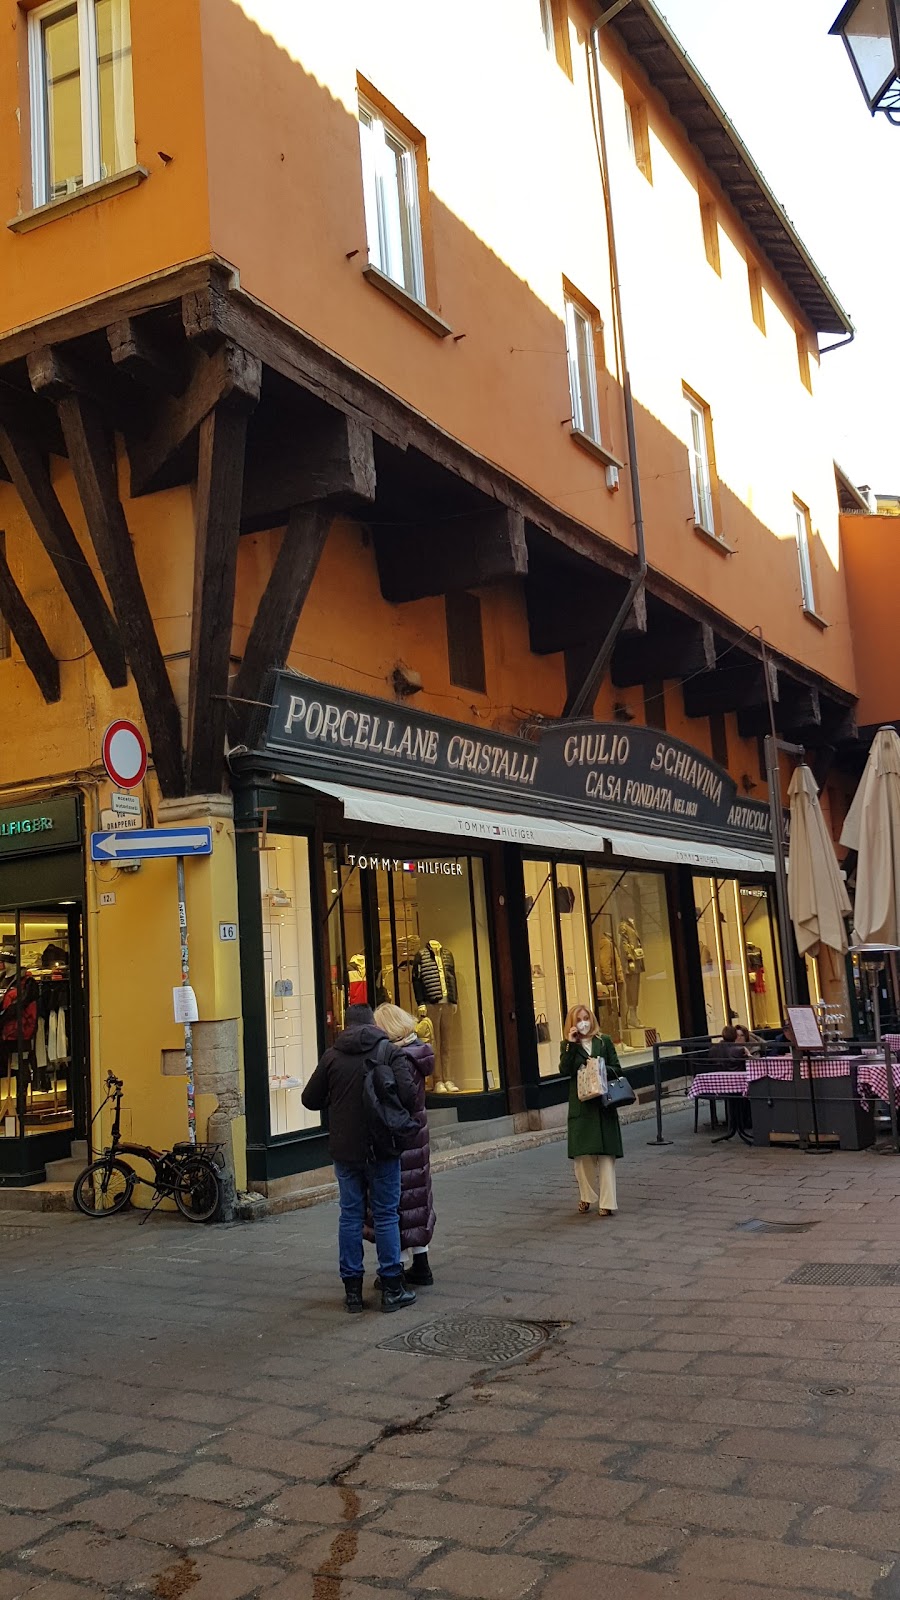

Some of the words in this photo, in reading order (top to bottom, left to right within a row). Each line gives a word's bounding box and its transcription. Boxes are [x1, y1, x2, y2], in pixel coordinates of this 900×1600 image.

[284, 695, 439, 765] PORCELLANE
[447, 735, 538, 785] CRISTALLI
[564, 734, 629, 767] GIULIO
[650, 742, 723, 807] SCHIAVINA
[585, 770, 621, 803] CASA
[623, 779, 672, 812] FONDATA
[672, 797, 685, 815] NEL
[0, 817, 53, 836] LFIGER
[106, 819, 137, 830] DRAPPERIE
[726, 804, 769, 832] ARTICOLI
[458, 820, 491, 834] TOMMY
[501, 828, 535, 840] HILFIGER
[348, 855, 399, 873] TOMMY
[417, 861, 463, 876] HILFIGER
[222, 926, 234, 938] 16
